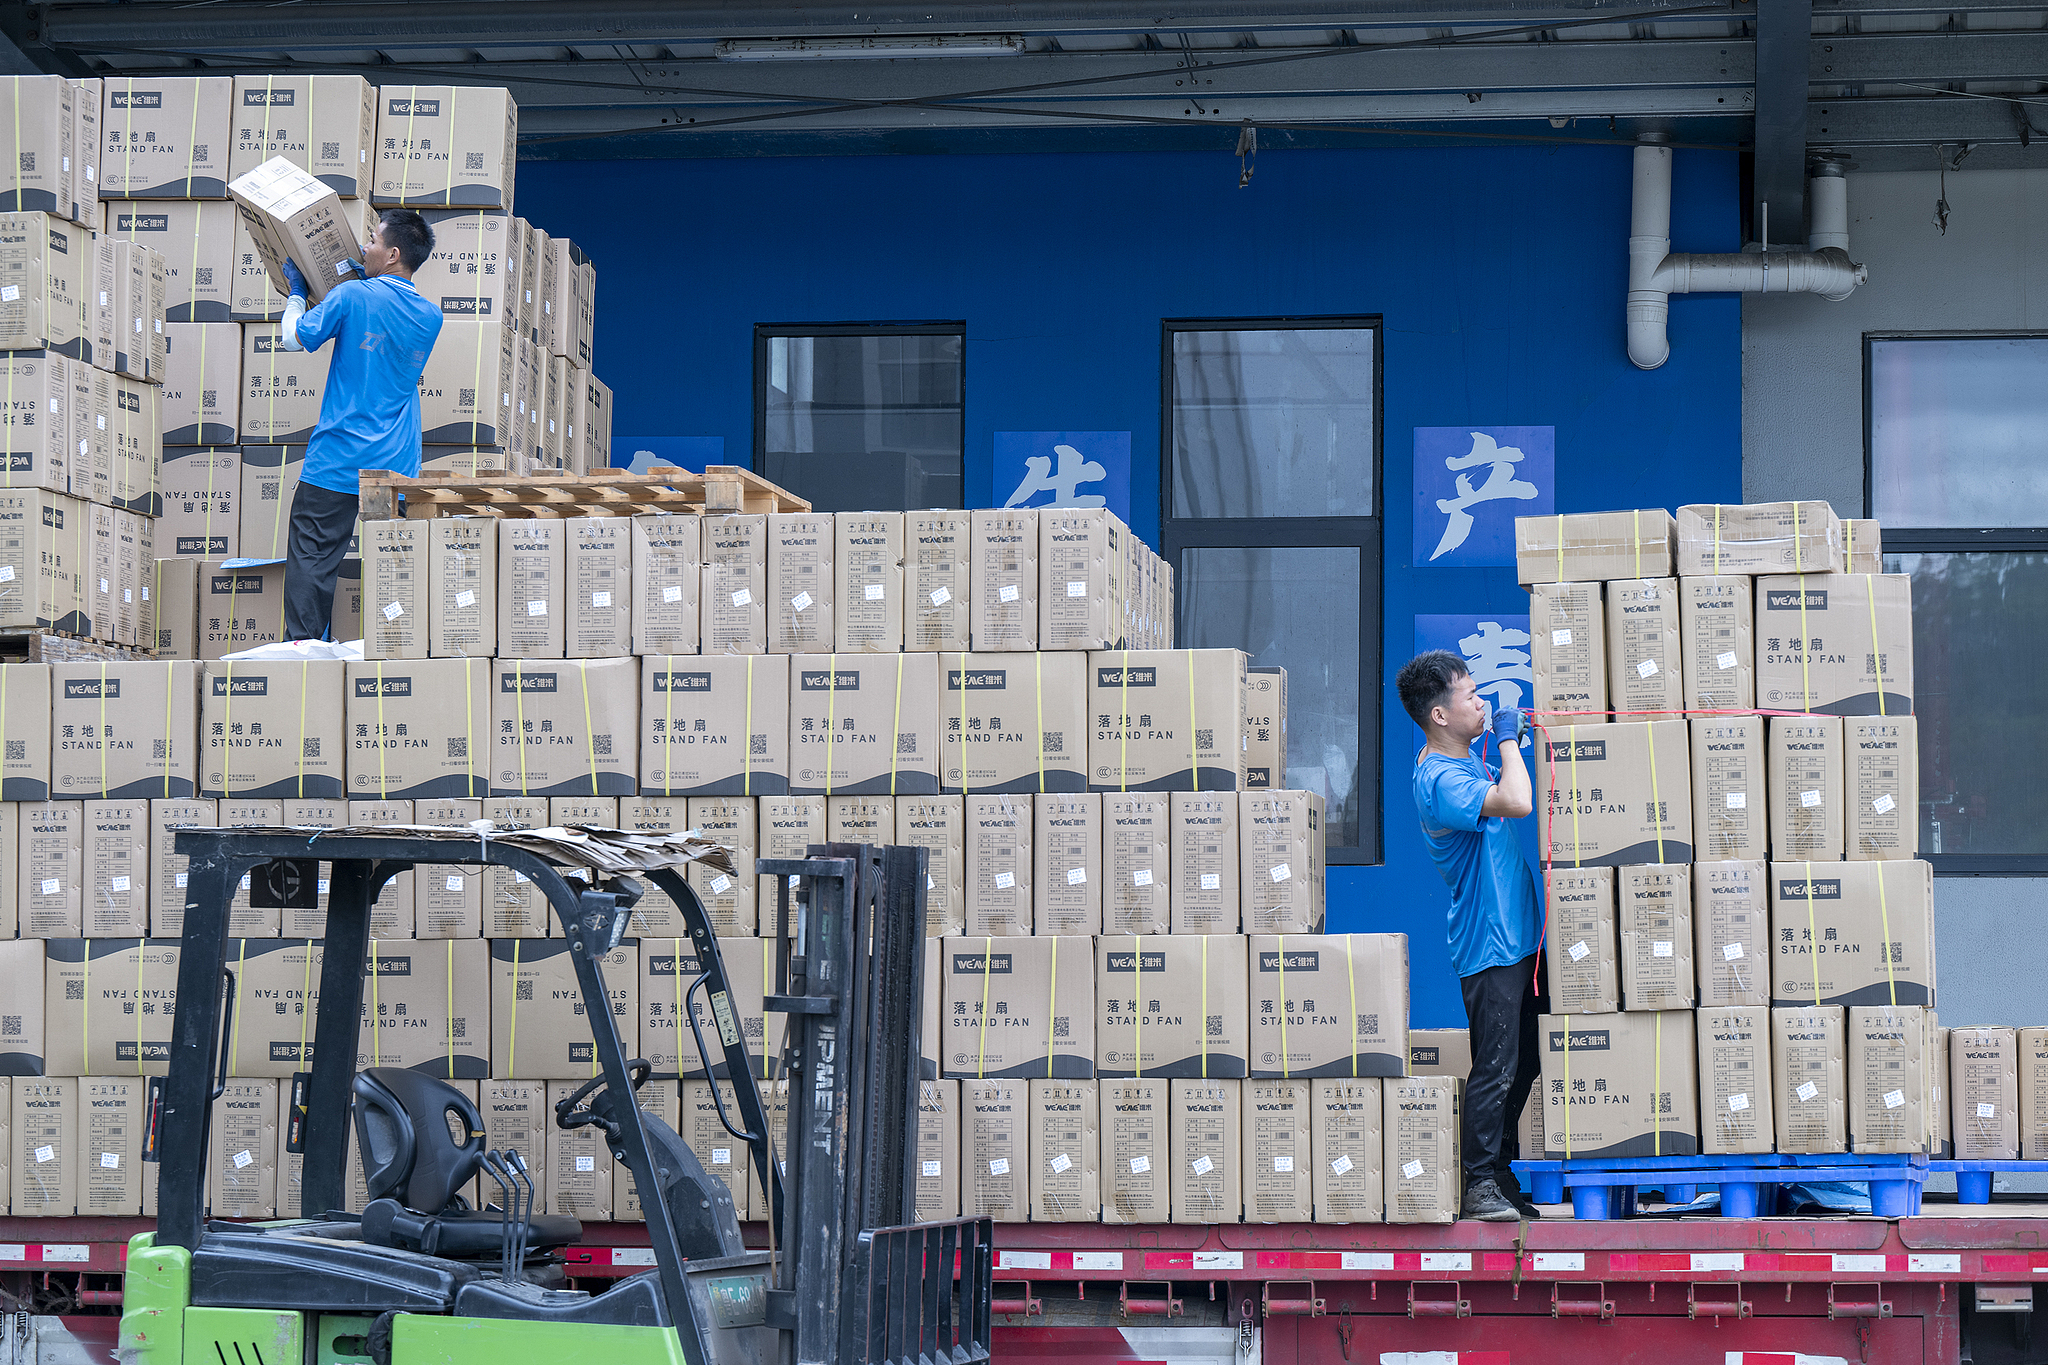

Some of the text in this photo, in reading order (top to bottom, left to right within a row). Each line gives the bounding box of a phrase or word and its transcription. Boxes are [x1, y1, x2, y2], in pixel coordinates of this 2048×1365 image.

[283, 143, 305, 151] FAN
[421, 389, 442, 397] FAN
[1429, 431, 1539, 561] 产
[1820, 655, 1845, 663] FAN
[999, 734, 1022, 742] FAN
[1149, 731, 1172, 739] FAN
[259, 739, 281, 747] FAN
[405, 739, 427, 747] FAN
[550, 736, 572, 744] FAN
[110, 741, 133, 749] FAN
[1600, 805, 1625, 813] FAN
[1835, 944, 1859, 953] FAN
[103, 990, 126, 998] FAN
[255, 990, 278, 998] FAN
[553, 991, 576, 999] FAN
[404, 1019, 427, 1027] FAN
[1005, 1018, 1028, 1026] FAN
[1158, 1017, 1181, 1025] FAN
[1312, 1016, 1336, 1024] FAN
[1604, 1095, 1629, 1104] FAN
